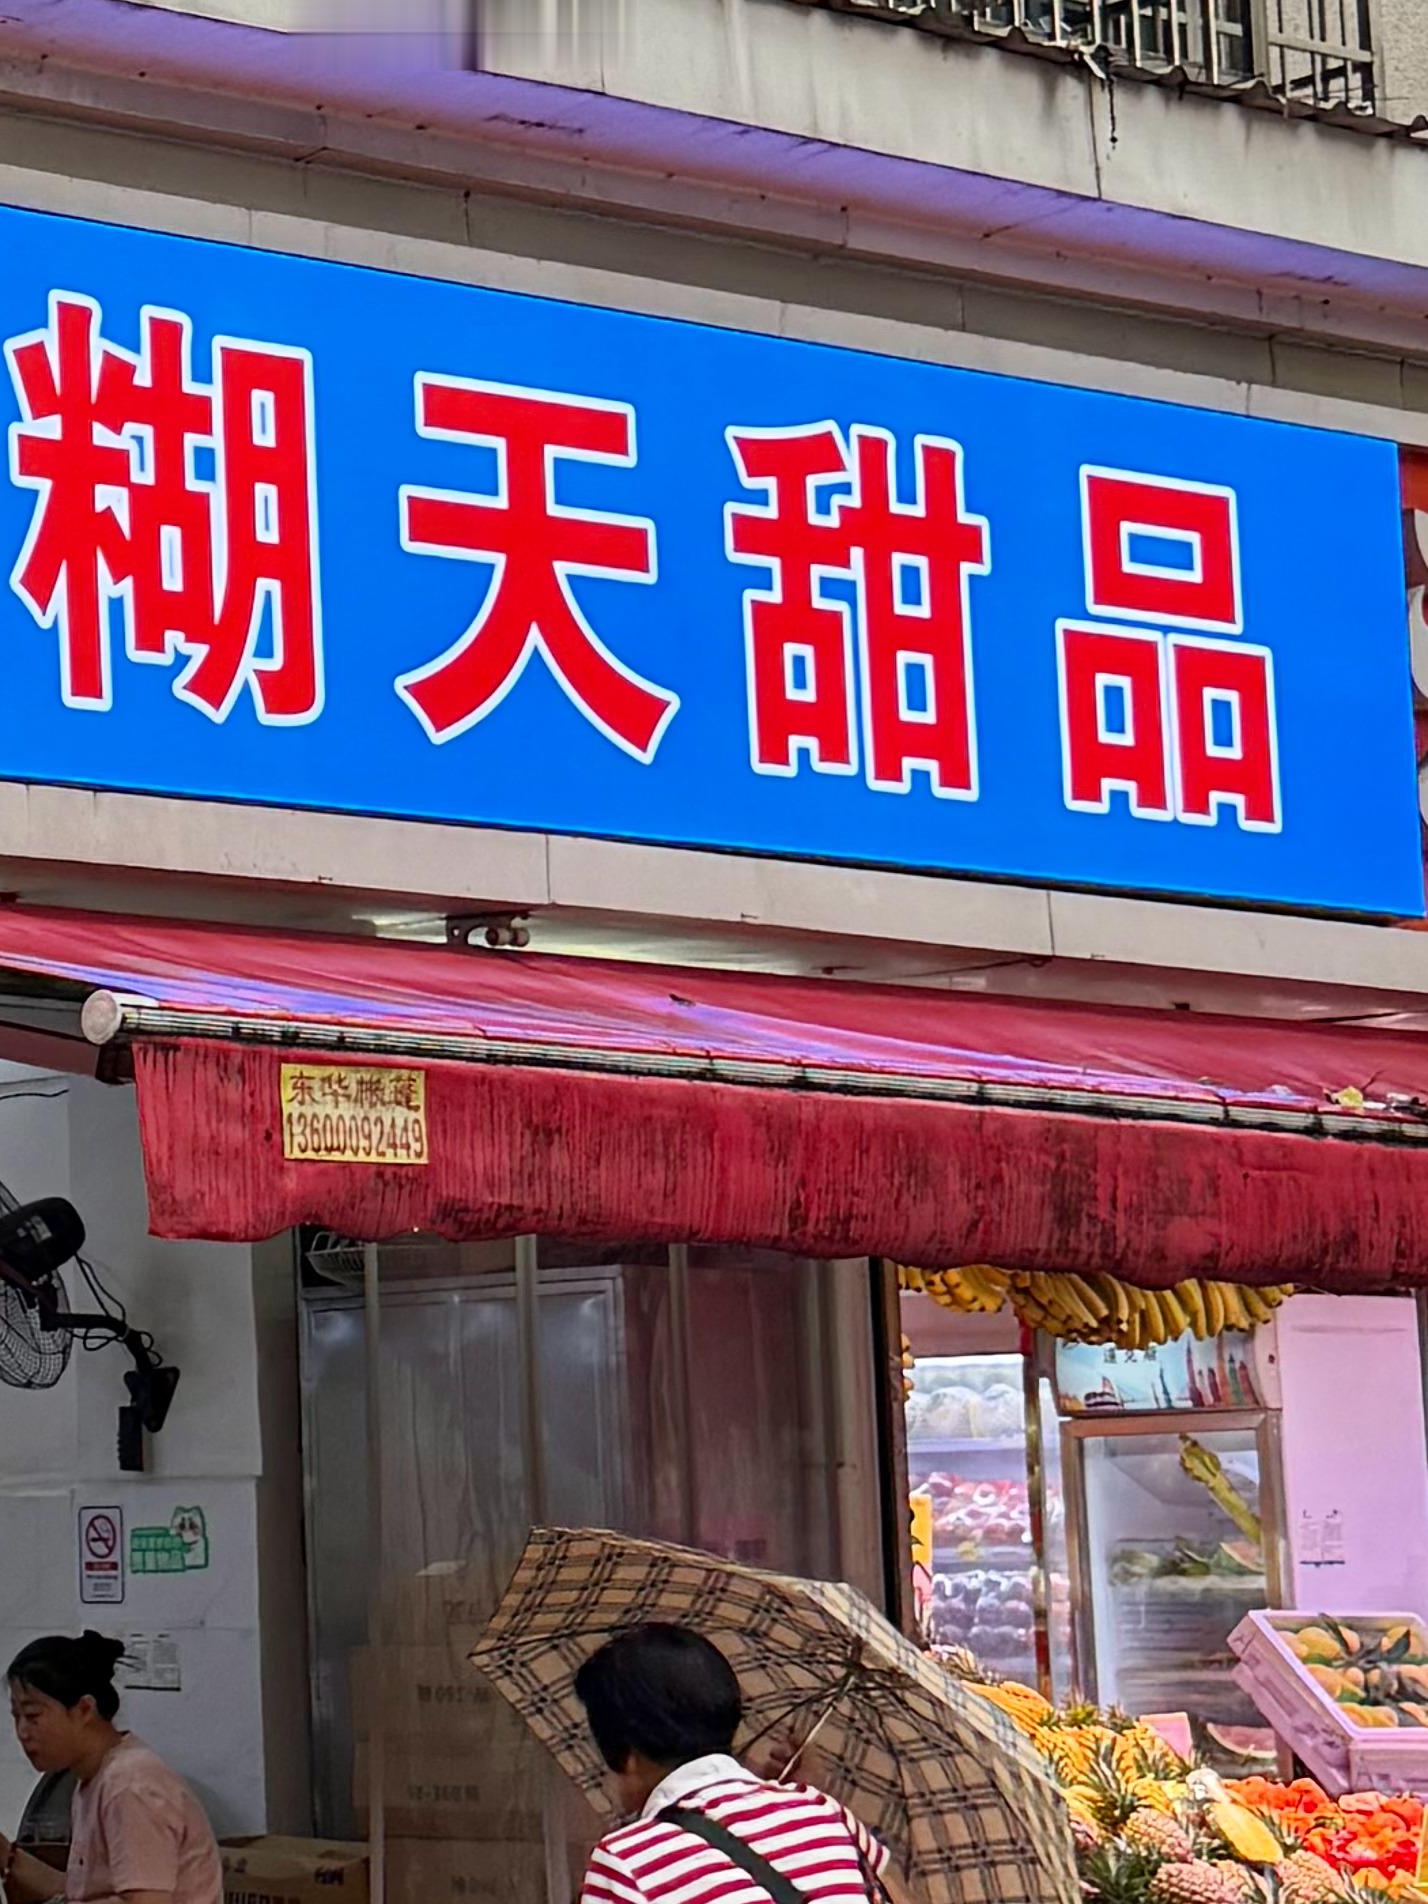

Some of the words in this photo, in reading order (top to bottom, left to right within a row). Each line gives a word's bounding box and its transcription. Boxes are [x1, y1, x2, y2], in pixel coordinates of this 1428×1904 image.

[3, 288, 1282, 834] 糊天甜品
[287, 1112, 424, 1158] 13600092449
